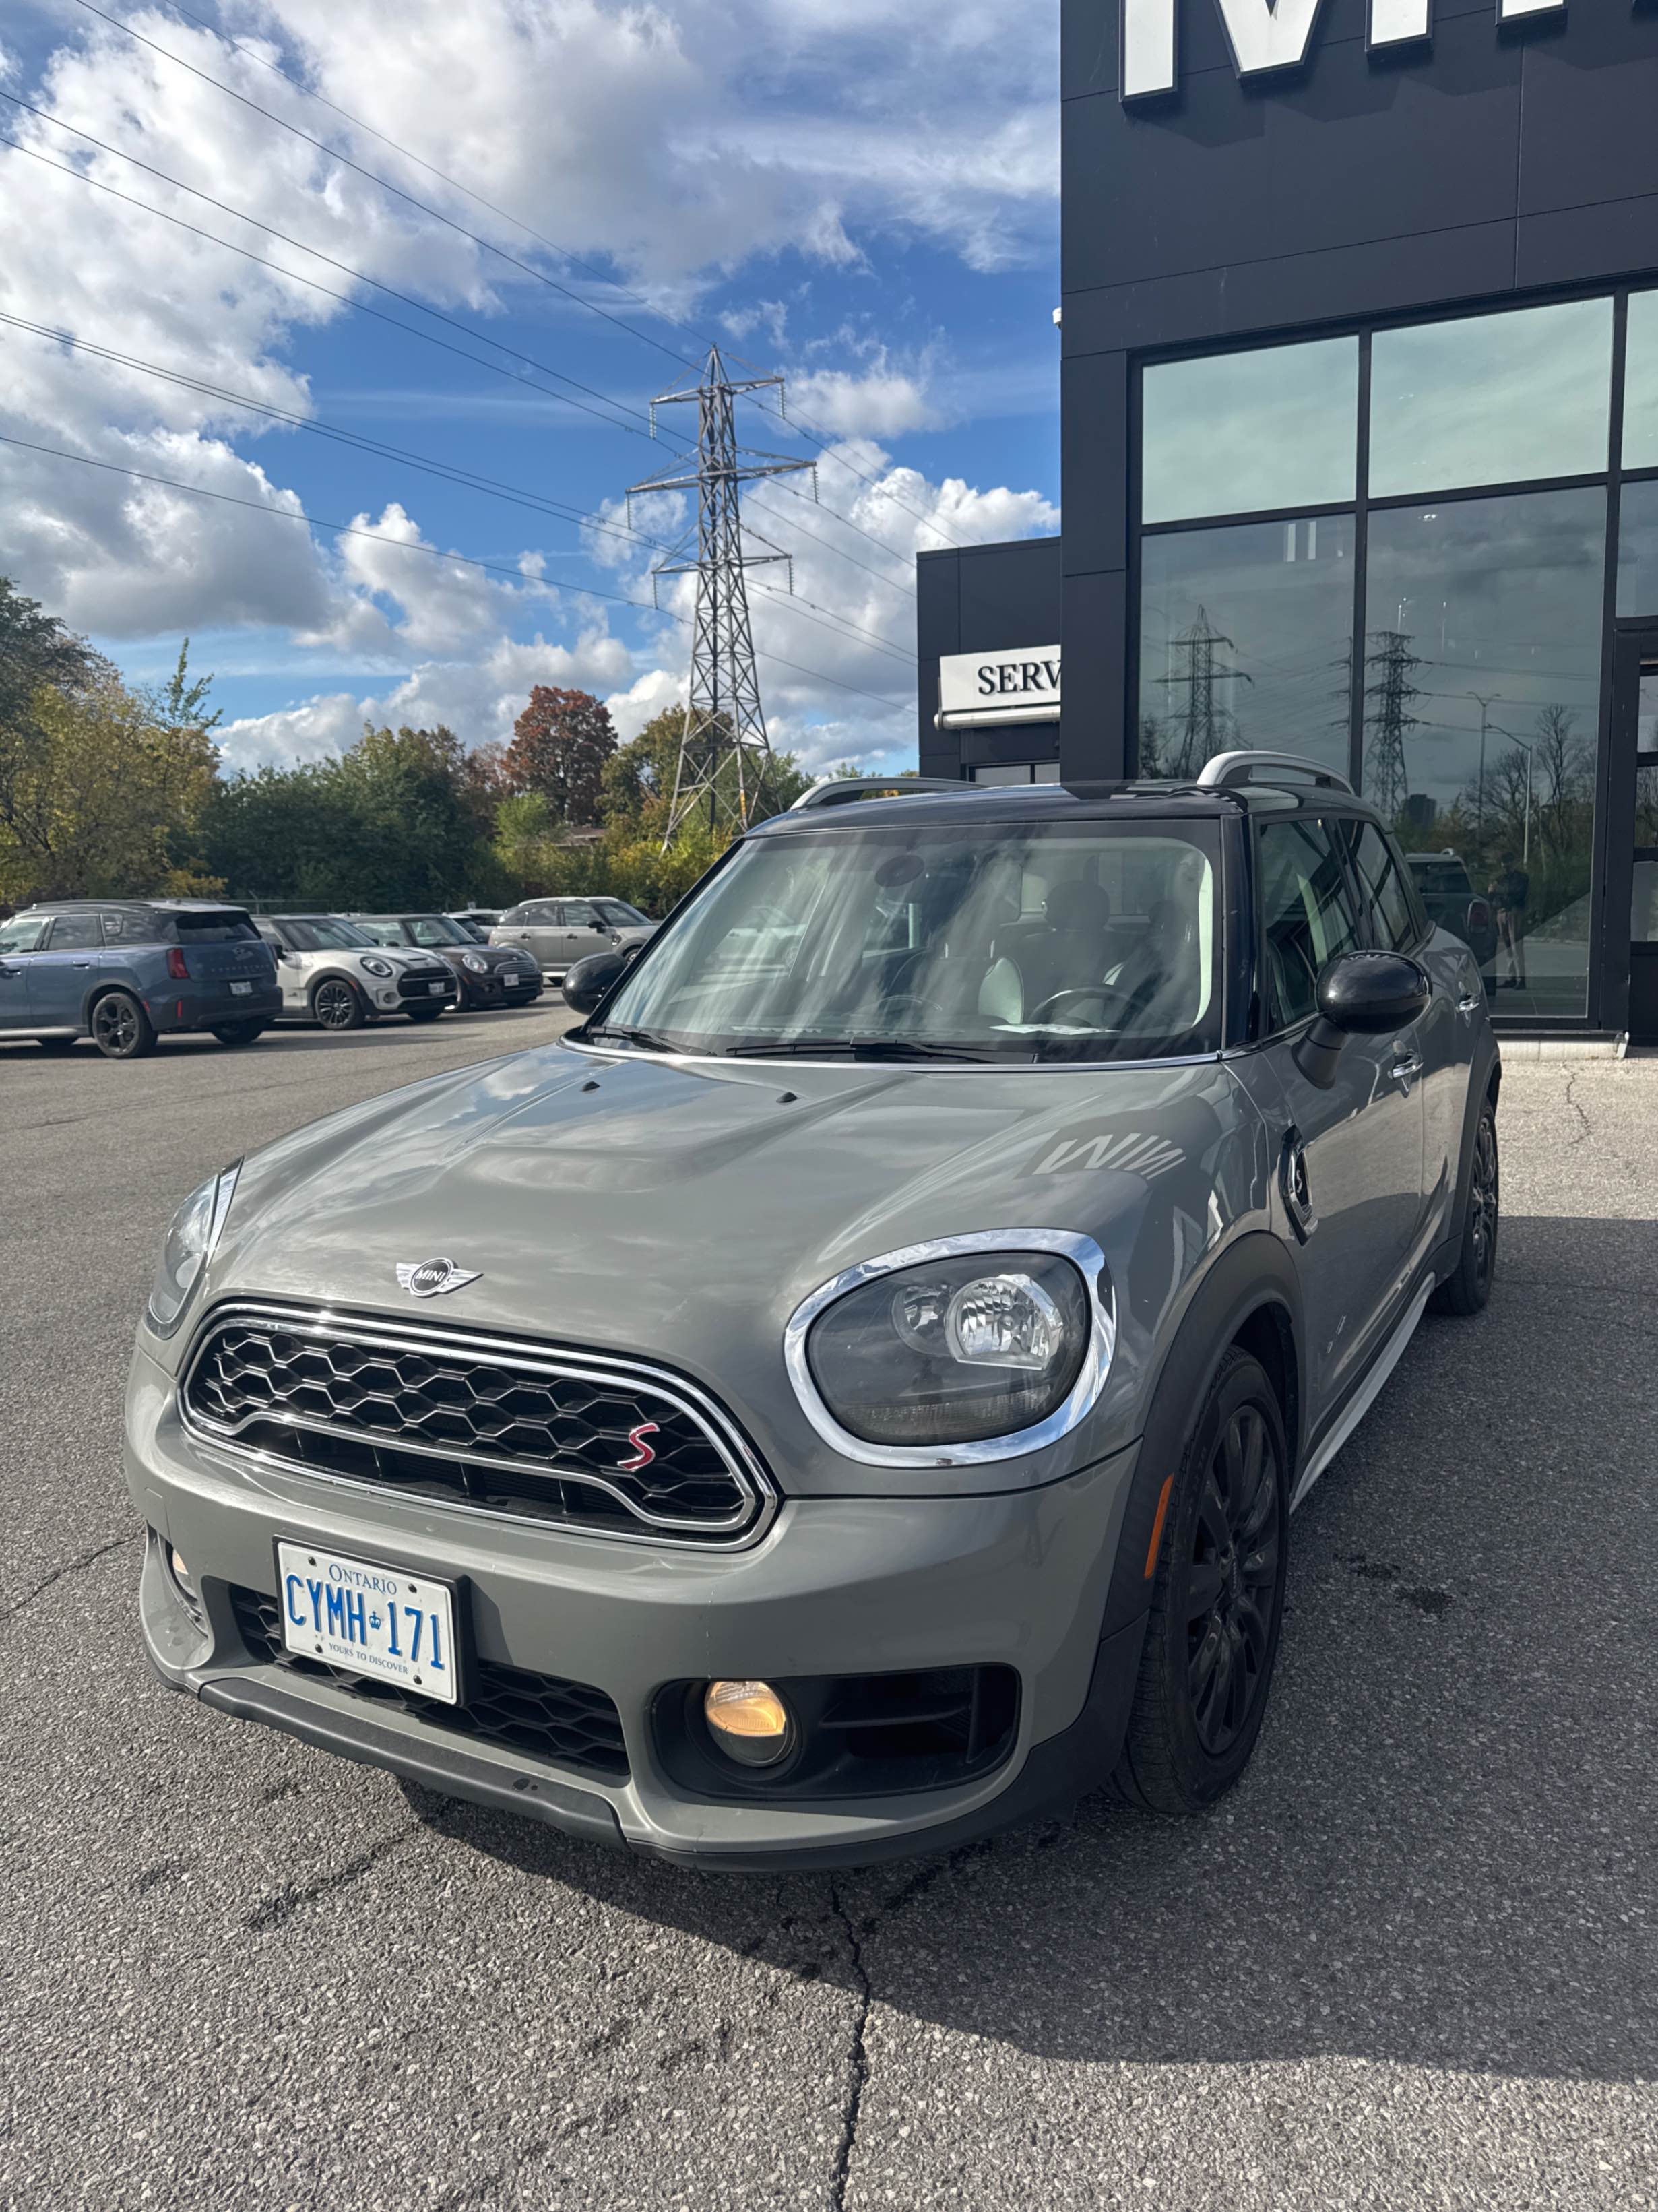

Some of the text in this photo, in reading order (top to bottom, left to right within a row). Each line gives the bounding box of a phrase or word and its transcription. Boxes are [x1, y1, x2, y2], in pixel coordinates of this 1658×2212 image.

[978, 660, 1061, 695] SERV
[416, 1270, 447, 1282] MINI
[617, 1422, 660, 1471] S
[329, 1643, 408, 1675] YOURS TO DISCOVER
